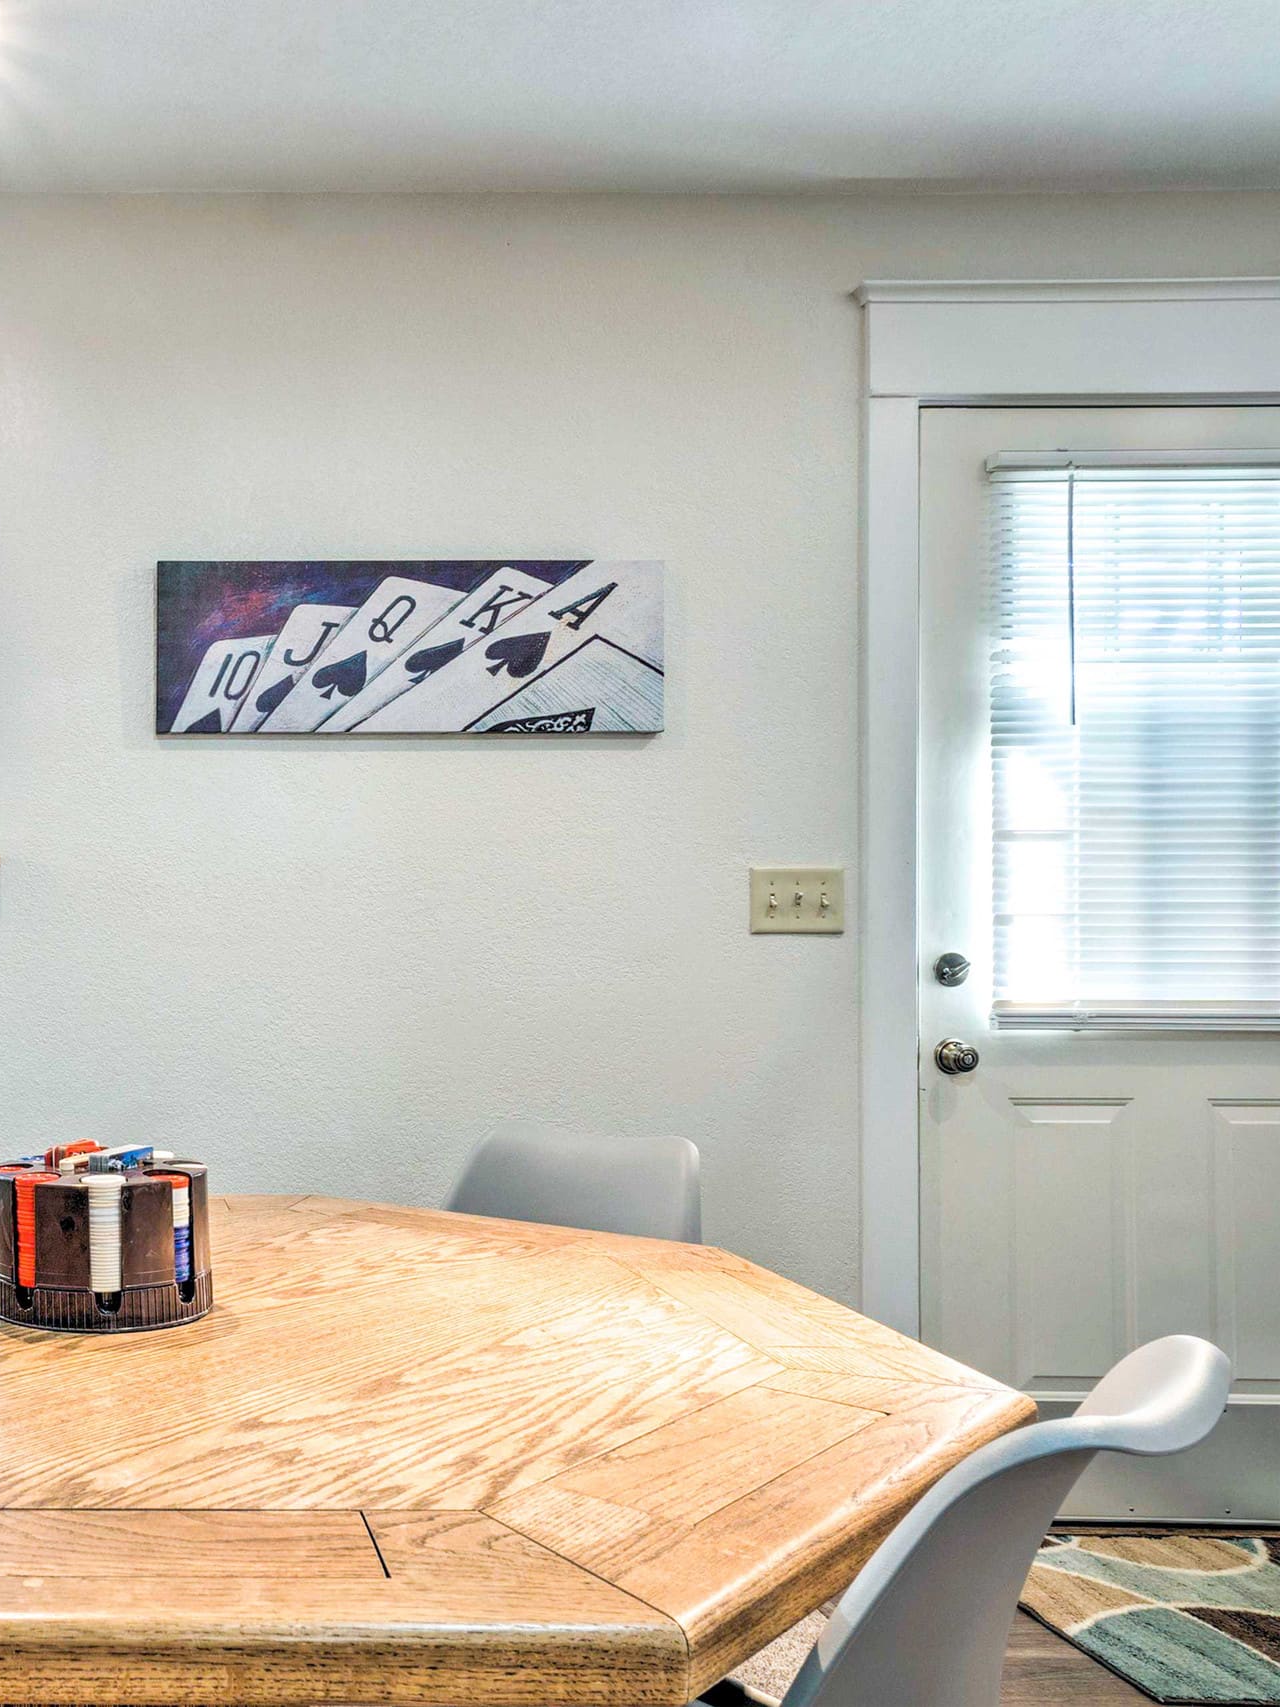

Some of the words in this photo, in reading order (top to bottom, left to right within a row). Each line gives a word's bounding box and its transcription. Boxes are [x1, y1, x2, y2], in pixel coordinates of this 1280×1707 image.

[208, 650, 260, 699] 10
[283, 621, 340, 667] J
[367, 594, 417, 644] Q
[460, 584, 534, 635] K
[548, 581, 618, 632] A
